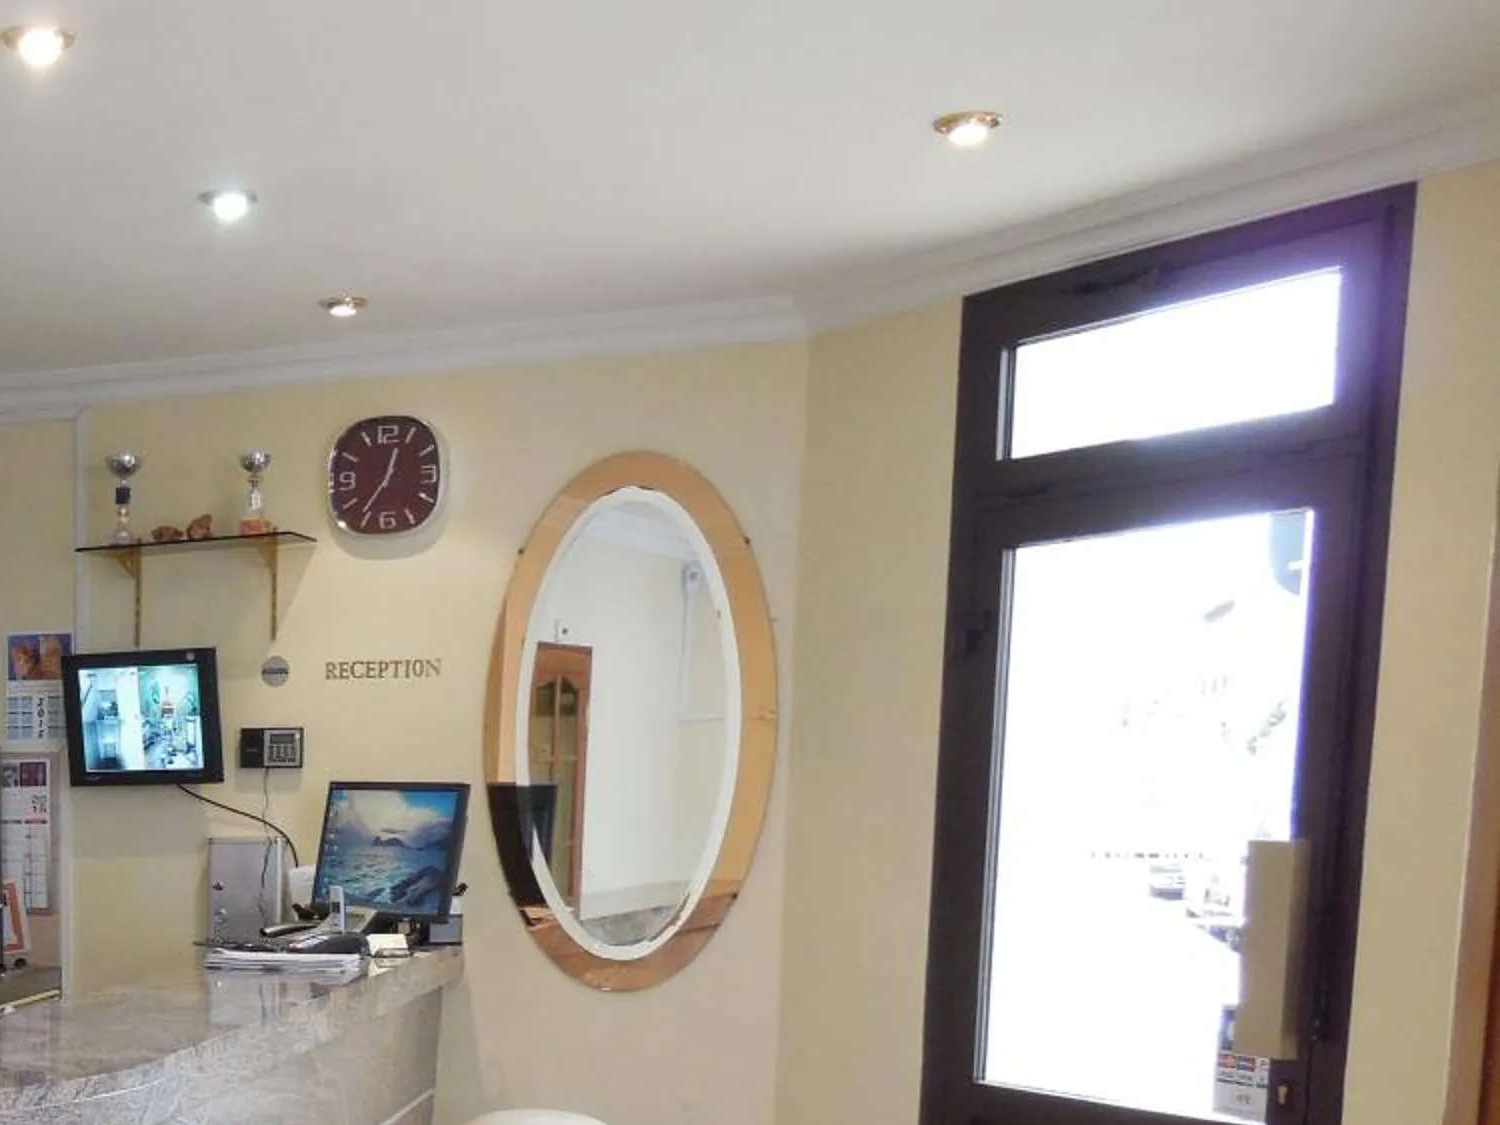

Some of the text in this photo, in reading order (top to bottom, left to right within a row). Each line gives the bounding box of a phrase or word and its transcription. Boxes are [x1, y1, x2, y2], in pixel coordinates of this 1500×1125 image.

[377, 425, 399, 444] 12
[339, 471, 356, 491] 9
[420, 464, 437, 484] 3
[379, 511, 397, 529] 6
[324, 658, 442, 680] RECEPTION
